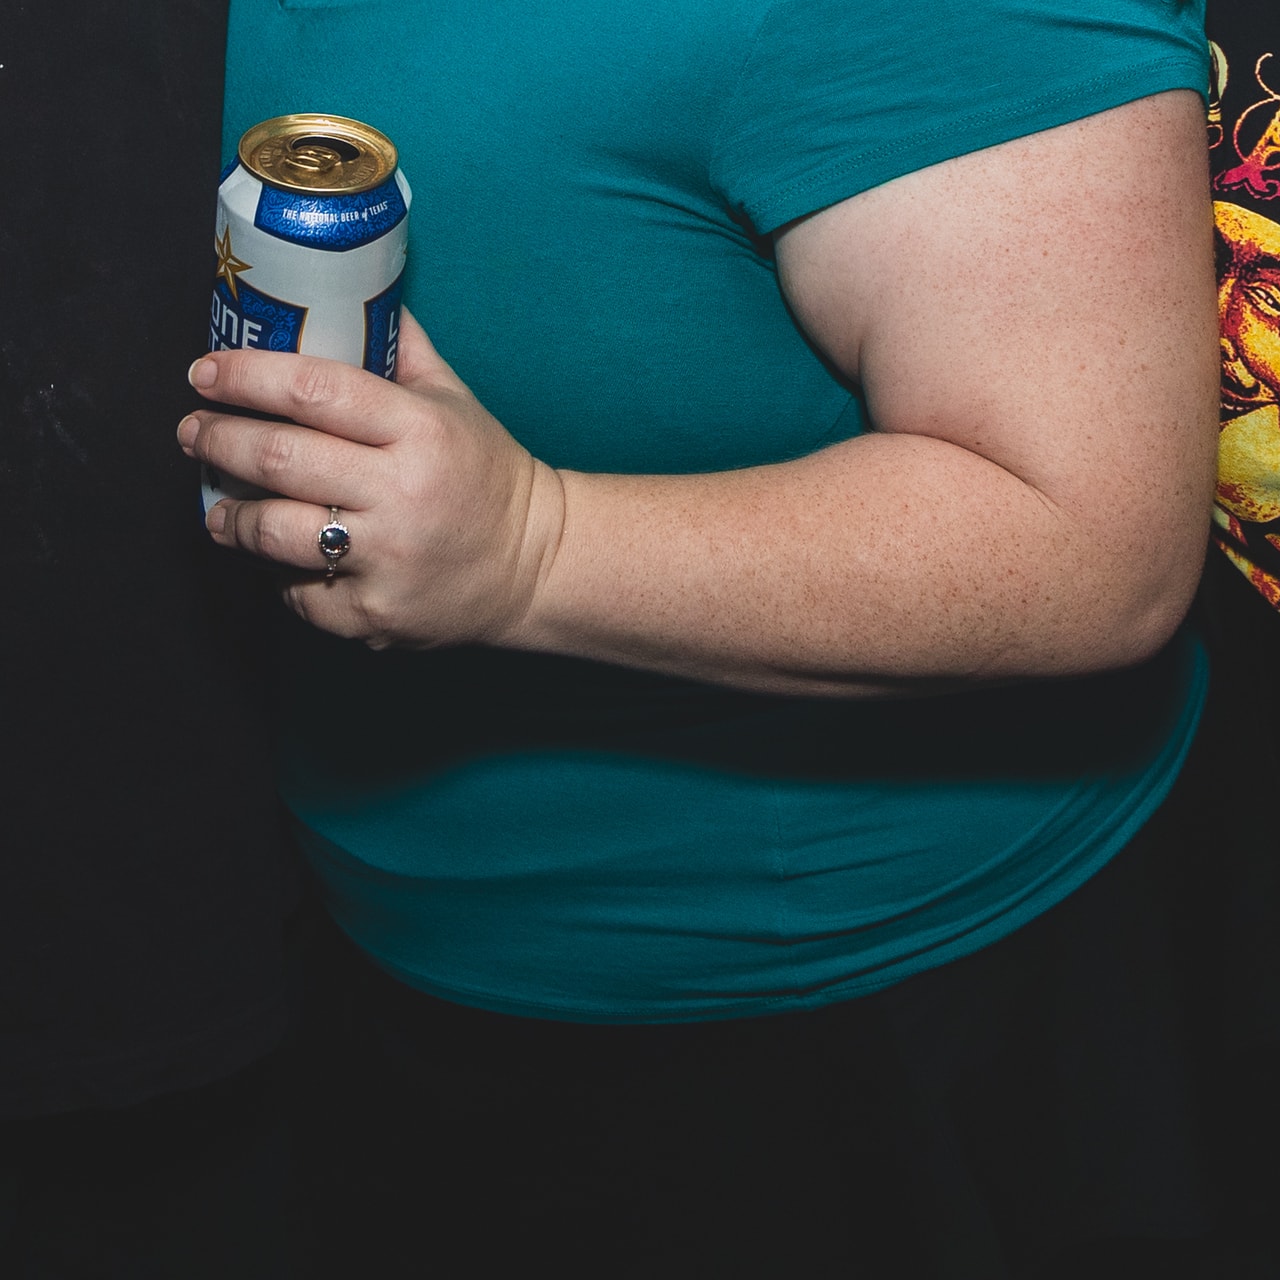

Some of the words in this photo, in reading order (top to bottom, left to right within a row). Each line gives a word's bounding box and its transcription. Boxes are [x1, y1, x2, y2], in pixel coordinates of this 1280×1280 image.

[282, 208, 297, 221] THE
[299, 211, 340, 225] NATIONAL
[341, 209, 360, 223] BEER
[361, 207, 369, 222] of
[369, 201, 389, 216] TEXAS
